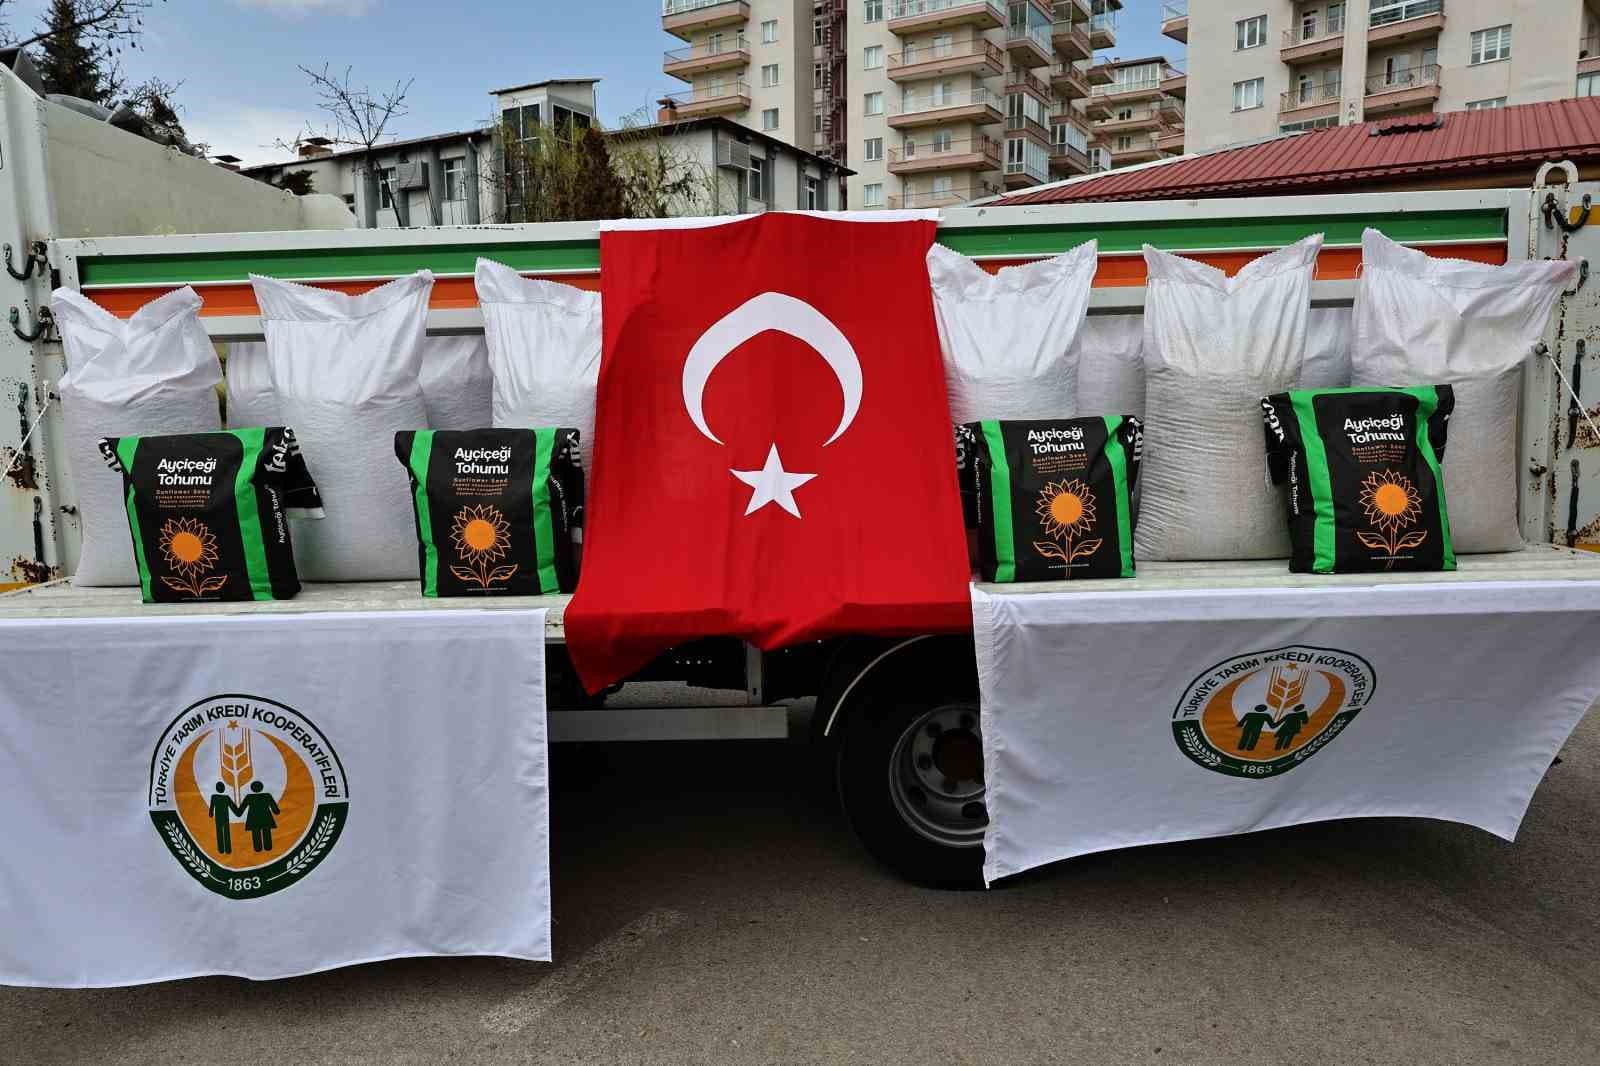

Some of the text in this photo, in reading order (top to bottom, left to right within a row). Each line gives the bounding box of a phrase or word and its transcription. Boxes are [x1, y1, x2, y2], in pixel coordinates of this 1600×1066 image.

[1343, 414, 1404, 433] Ayçiçeği
[1027, 426, 1084, 443] Ayçiçeği
[1347, 432, 1405, 444] Tohumu
[454, 446, 512, 462] Ayçiçeği
[1030, 442, 1085, 455] Tohumu
[157, 457, 217, 473] Ayçiçeği
[455, 462, 509, 474] Tohumu
[158, 473, 213, 485] Tohumu
[1183, 677, 1220, 718] TÜRKİYE
[1215, 658, 1260, 683] TARIM
[1263, 651, 1314, 665] KREDİ
[154, 703, 341, 806] TÜRKİYE TARIM KREDİ KOOPERATİFLERİ
[1240, 764, 1273, 774] 1863
[227, 876, 262, 891] 1863
